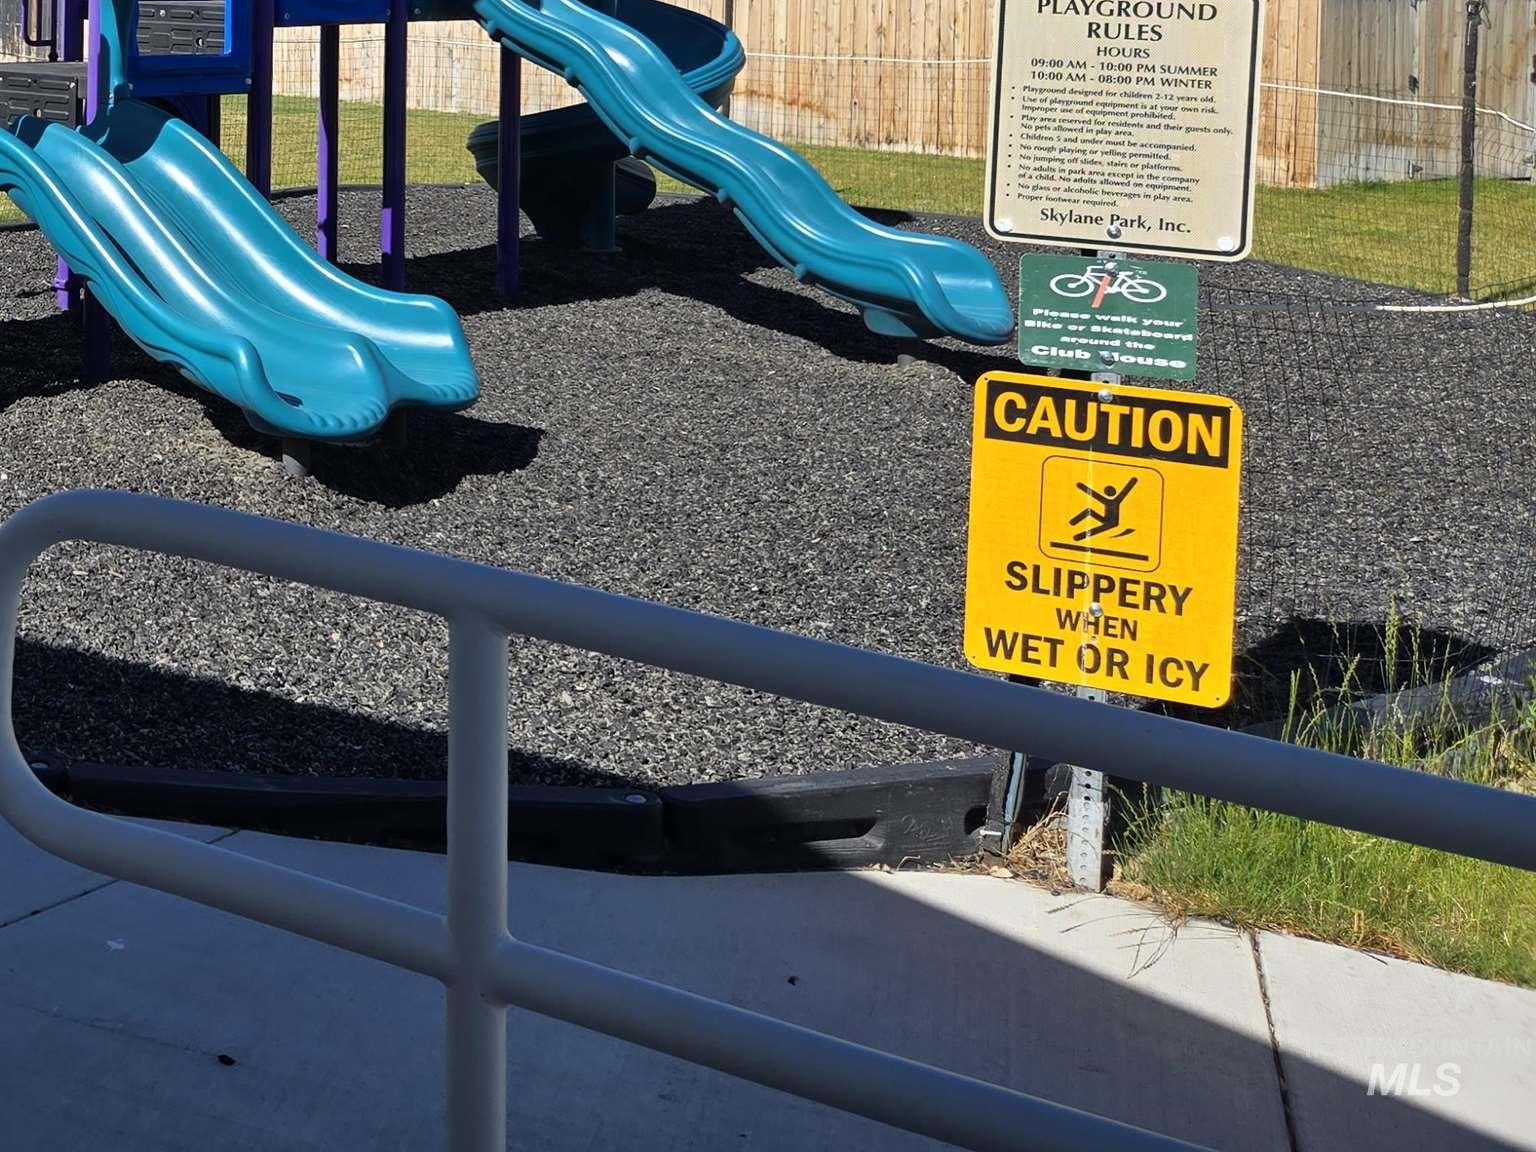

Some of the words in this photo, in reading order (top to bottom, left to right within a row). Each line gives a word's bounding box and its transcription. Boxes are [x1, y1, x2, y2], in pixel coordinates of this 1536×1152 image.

[1087, 22, 1163, 41] RULES
[1096, 46, 1151, 59] HOURS
[1031, 57, 1064, 69] 09:00
[1066, 60, 1087, 70] AM
[1100, 61, 1133, 72] 10:00
[1137, 63, 1156, 73] PM
[1159, 64, 1218, 77] SUMMER
[1031, 71, 1064, 81] 10:00
[1066, 73, 1086, 82] AM
[1098, 74, 1132, 85] 08:00
[1136, 76, 1155, 86] PM
[1160, 77, 1213, 90] WINTER
[1022, 85, 1066, 96] Playground
[1068, 87, 1102, 98] designed
[1105, 89, 1117, 97] for
[1119, 90, 1152, 99] children
[1155, 92, 1173, 100] 2-12
[1021, 104, 1057, 113] Improper
[1085, 108, 1128, 117] equipment
[1130, 111, 1175, 120] prohibited.
[1049, 97, 1093, 107] playground
[1095, 100, 1138, 110] equipment
[1021, 114, 1037, 123] Play
[1107, 120, 1143, 128] residents
[1184, 124, 1210, 134] guests
[1034, 124, 1050, 132] pets
[1095, 127, 1112, 136] play
[1020, 133, 1053, 141] Children
[1062, 135, 1077, 143] and
[1080, 136, 1103, 144] under
[1105, 138, 1125, 146] must
[1139, 140, 1196, 152] accompanied.
[1033, 144, 1056, 153] rough
[1058, 146, 1087, 155] playing
[1033, 155, 1065, 164] jumping
[1067, 167, 1085, 176] park
[1107, 170, 1133, 180] except
[1161, 175, 1199, 185] company
[1073, 176, 1096, 184] adults
[1099, 178, 1130, 186] allowed
[1017, 193, 1042, 202] Proper
[1045, 195, 1079, 203] footwear
[1031, 183, 1050, 193] glass
[1063, 186, 1099, 194] alcoholic
[1101, 188, 1141, 199] beverages
[1153, 192, 1170, 202] play
[1040, 208, 1104, 226] Skylane
[1109, 214, 1152, 232] Park,
[1159, 218, 1191, 233] Inc.
[1032, 308, 1091, 319] Please
[1095, 314, 1138, 324] walk
[1141, 318, 1184, 327] your
[1024, 320, 1062, 330] Bike
[1090, 325, 1193, 341] Skateboard
[1060, 336, 1121, 346] around
[1125, 341, 1155, 349] the
[1031, 345, 1091, 360] Club
[992, 391, 1223, 458] CAUTION
[1004, 561, 1193, 616] SLIPPERY
[1055, 608, 1138, 641] WHEN
[984, 627, 1065, 668] WET
[1076, 643, 1130, 680] OR
[1144, 653, 1210, 692] ICY
